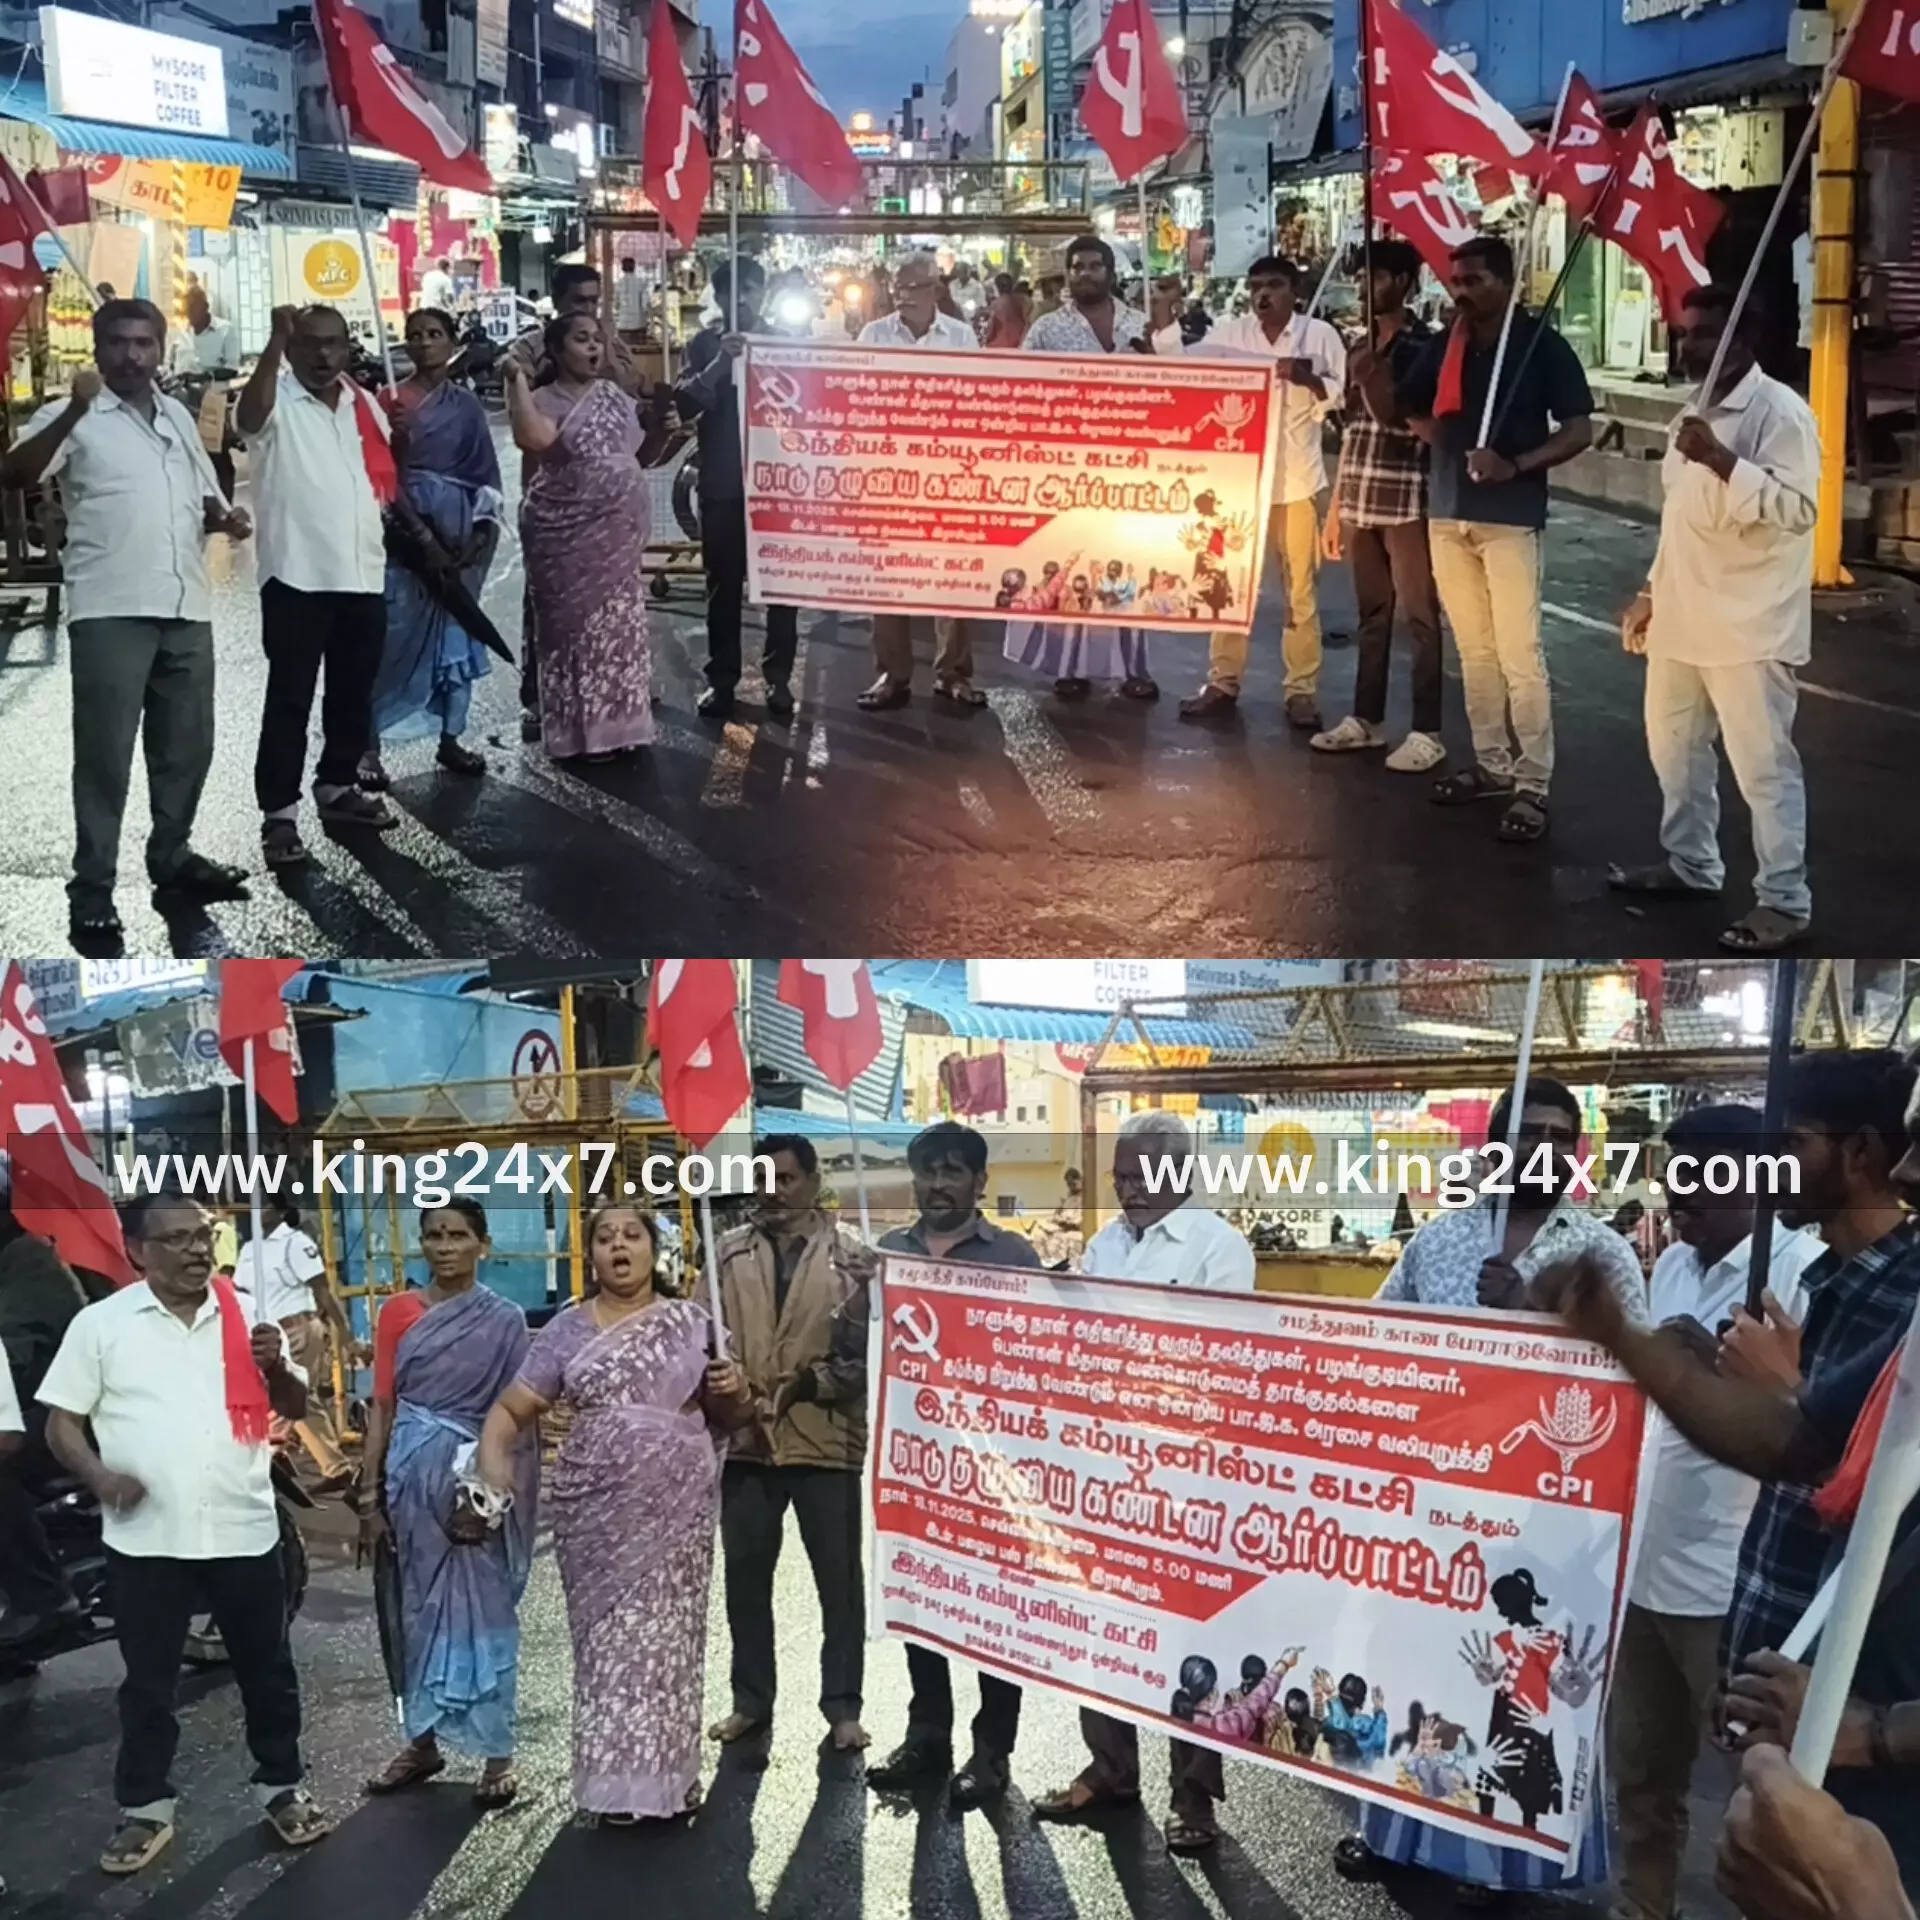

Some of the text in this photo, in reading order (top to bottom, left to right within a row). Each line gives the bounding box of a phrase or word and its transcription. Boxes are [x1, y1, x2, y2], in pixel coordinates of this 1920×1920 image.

[151, 56, 206, 81] MYSORE
[153, 80, 198, 101] FILTER
[156, 104, 203, 127] COFFEE
[907, 437, 1076, 468] கம்யூனிஸ்ட்
[1085, 449, 1149, 470] கட்சி
[1215, 436, 1245, 452] CPI
[754, 461, 1191, 514] நாடு தழுவிய கண்டன ஆர்ப்பாட்டம்
[1094, 960, 1149, 982] FILTER
[966, 1307, 1027, 1333] நாளுக்கு
[1030, 1313, 1070, 1336] நாள்
[1073, 1319, 1154, 1353] அதிகரித்து
[1158, 1333, 1204, 1357] வரும்
[1278, 1314, 1379, 1339] சமத்துவம்
[1383, 1327, 1440, 1347] காண
[900, 1360, 927, 1381] CPI
[992, 1336, 1063, 1364] பெண்கள்
[1066, 1343, 1123, 1373] மீதான
[1265, 1380, 1420, 1422] தாக்குதல்களை
[1041, 1373, 1116, 1404] வேண்டும்
[1303, 1417, 1373, 1447] அரசை
[1377, 1432, 1494, 1473] வலியுறுத்தி
[915, 1387, 1521, 1538] இந்தியக் கம்யூனிஸ்ட் கட்சி நடத்தும்
[1537, 1472, 1593, 1504] CPI
[890, 1430, 945, 1488] நாடு
[1082, 1472, 1226, 1551] கண்டன
[1231, 1503, 1487, 1611] ஆர்ப்பாட்டம்
[1152, 1557, 1190, 1580] 5.00
[1195, 1570, 1232, 1592] மணி
[976, 1583, 1097, 1636] கம்யூனிஸ்ட்
[1103, 1621, 1157, 1652] கட்சி
